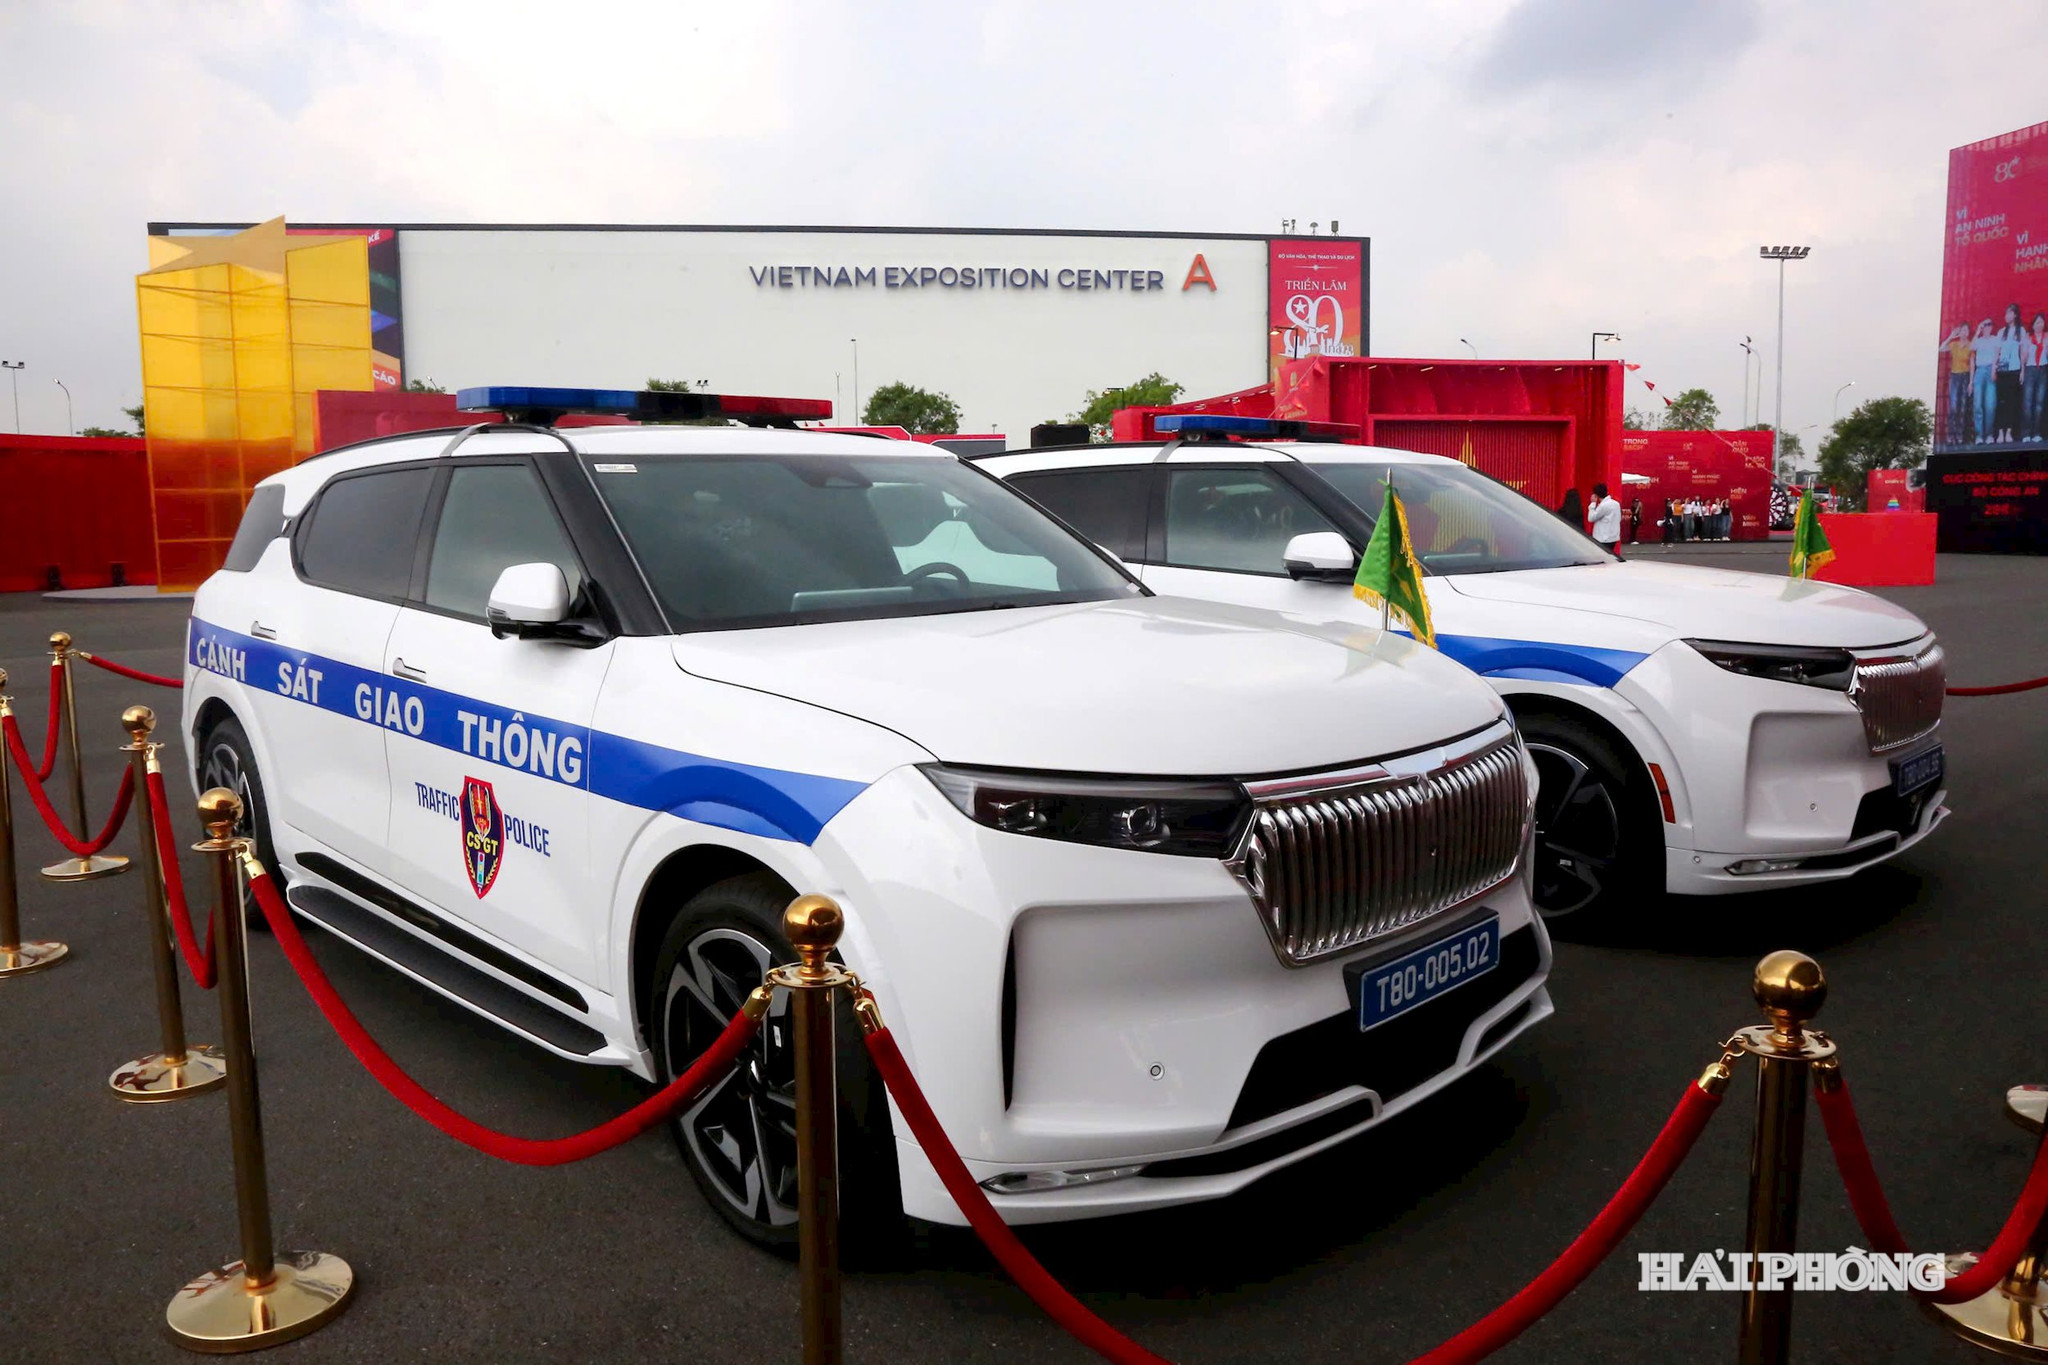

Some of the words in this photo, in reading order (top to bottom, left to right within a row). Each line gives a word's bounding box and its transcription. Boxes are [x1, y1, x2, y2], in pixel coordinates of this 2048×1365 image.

[1955, 222, 1972, 234] AN
[1975, 213, 2005, 229] NINH
[749, 265, 877, 288] VIETNAM
[884, 266, 1050, 291] EXPOSITION
[1057, 268, 1164, 292] CENTER
[1182, 253, 1217, 293] A
[277, 657, 323, 704] SÁT
[355, 682, 425, 737] GIAO
[457, 710, 583, 784] THÔNG
[414, 781, 460, 822] TRAFFIC
[504, 813, 551, 858] POLICE
[1376, 931, 1490, 1013] T80-005.02
